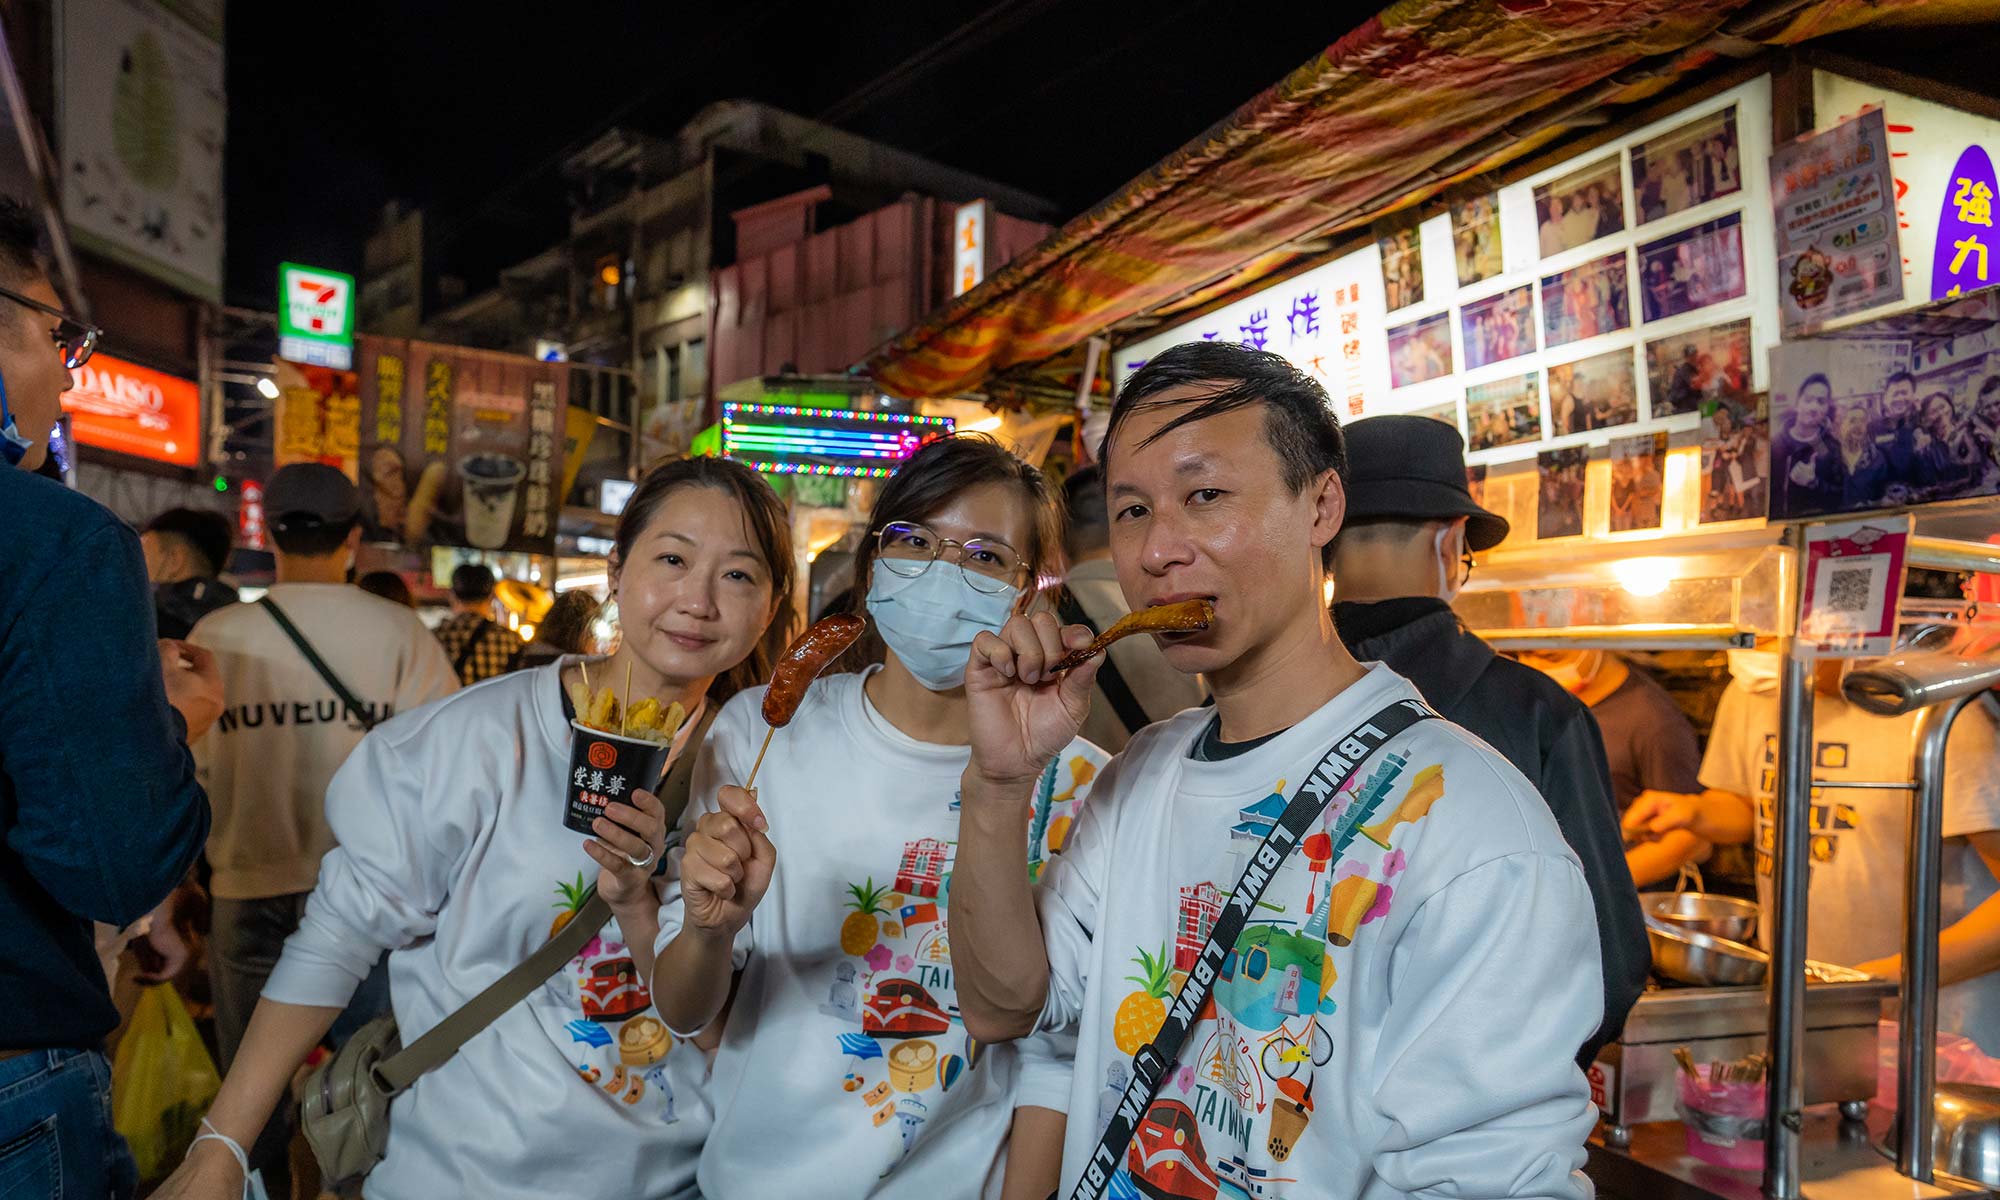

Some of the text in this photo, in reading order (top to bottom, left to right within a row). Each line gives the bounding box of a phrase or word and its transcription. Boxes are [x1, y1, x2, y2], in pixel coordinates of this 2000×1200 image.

[1948, 172, 1994, 299] 強力
[1301, 722, 1388, 805] LBWK
[1230, 823, 1296, 917] LBWK
[934, 920, 949, 932] GE
[917, 964, 957, 990] TAI
[1171, 938, 1226, 1031] LBWK
[1286, 969, 1299, 1001] 日月潭
[1195, 1083, 1254, 1153] TAIWAN
[1071, 1142, 1116, 1200] LBW
